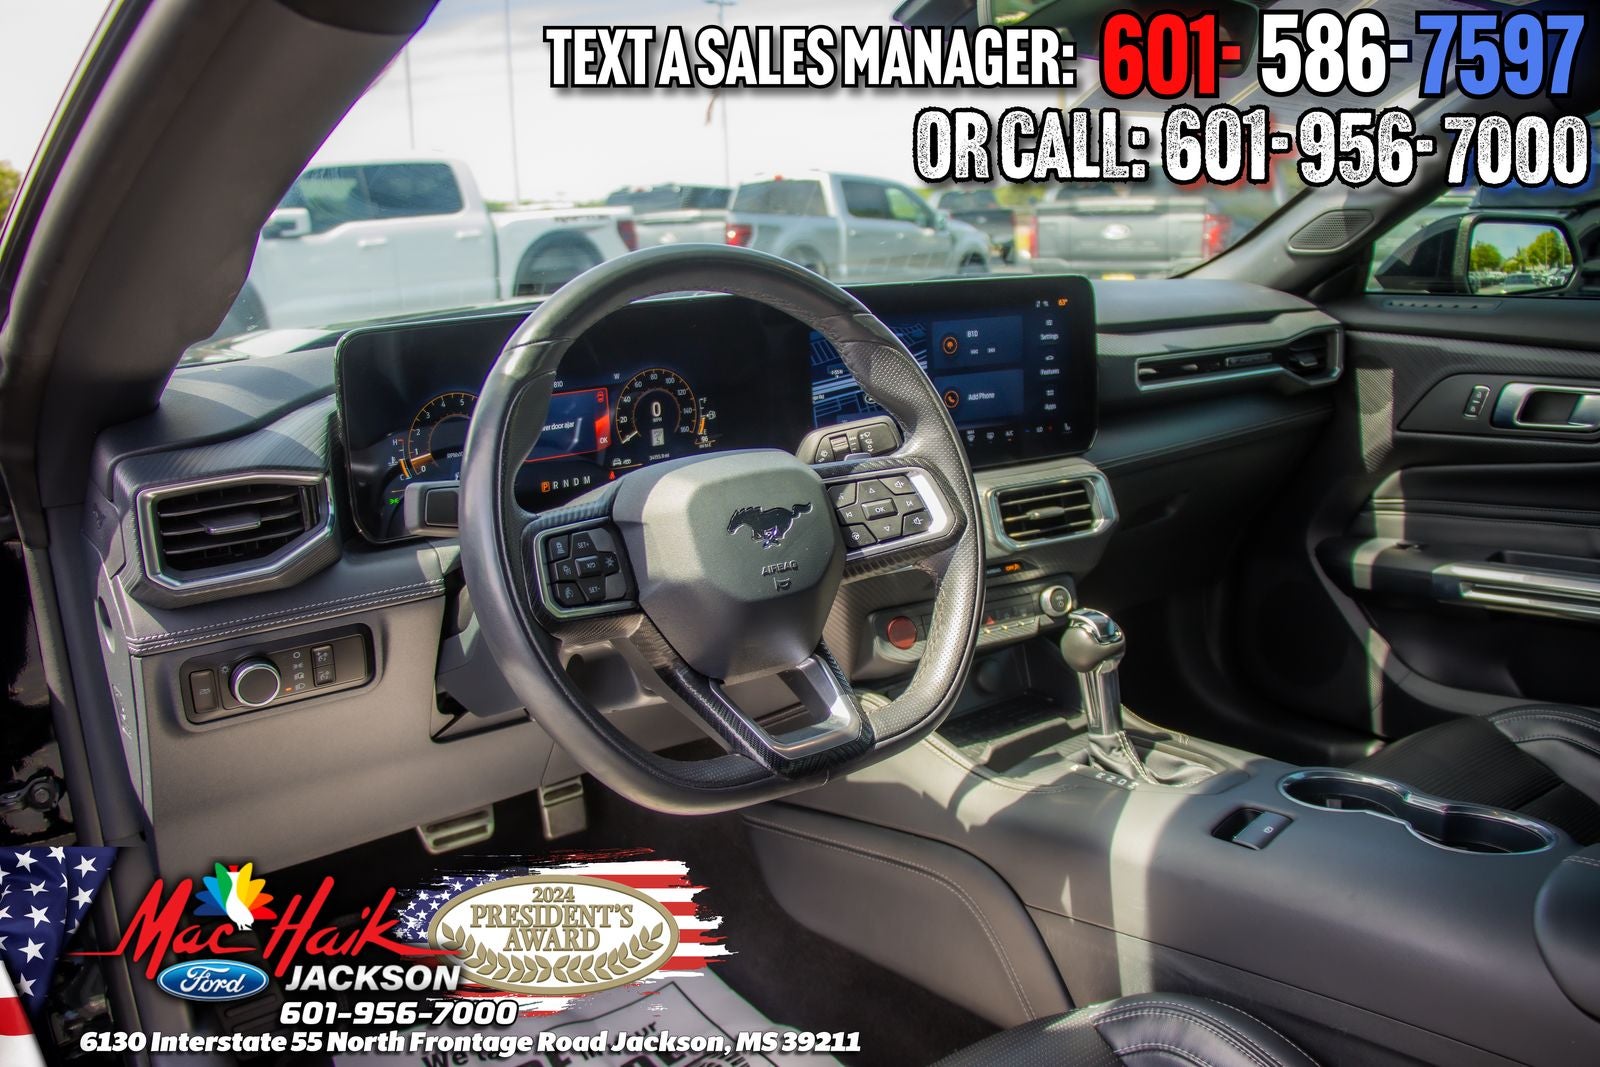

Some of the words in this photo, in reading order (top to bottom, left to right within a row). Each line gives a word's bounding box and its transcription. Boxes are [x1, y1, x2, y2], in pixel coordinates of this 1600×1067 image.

[623, 395, 631, 403] 40
[652, 401, 661, 417] 0
[426, 411, 431, 419] 3
[551, 423, 564, 431] door
[564, 421, 575, 429] ajar
[553, 481, 559, 489] R
[563, 479, 569, 487] N
[574, 478, 580, 486] D
[584, 476, 591, 484] M
[577, 541, 590, 549] SET+
[761, 559, 799, 576] AIRBAG
